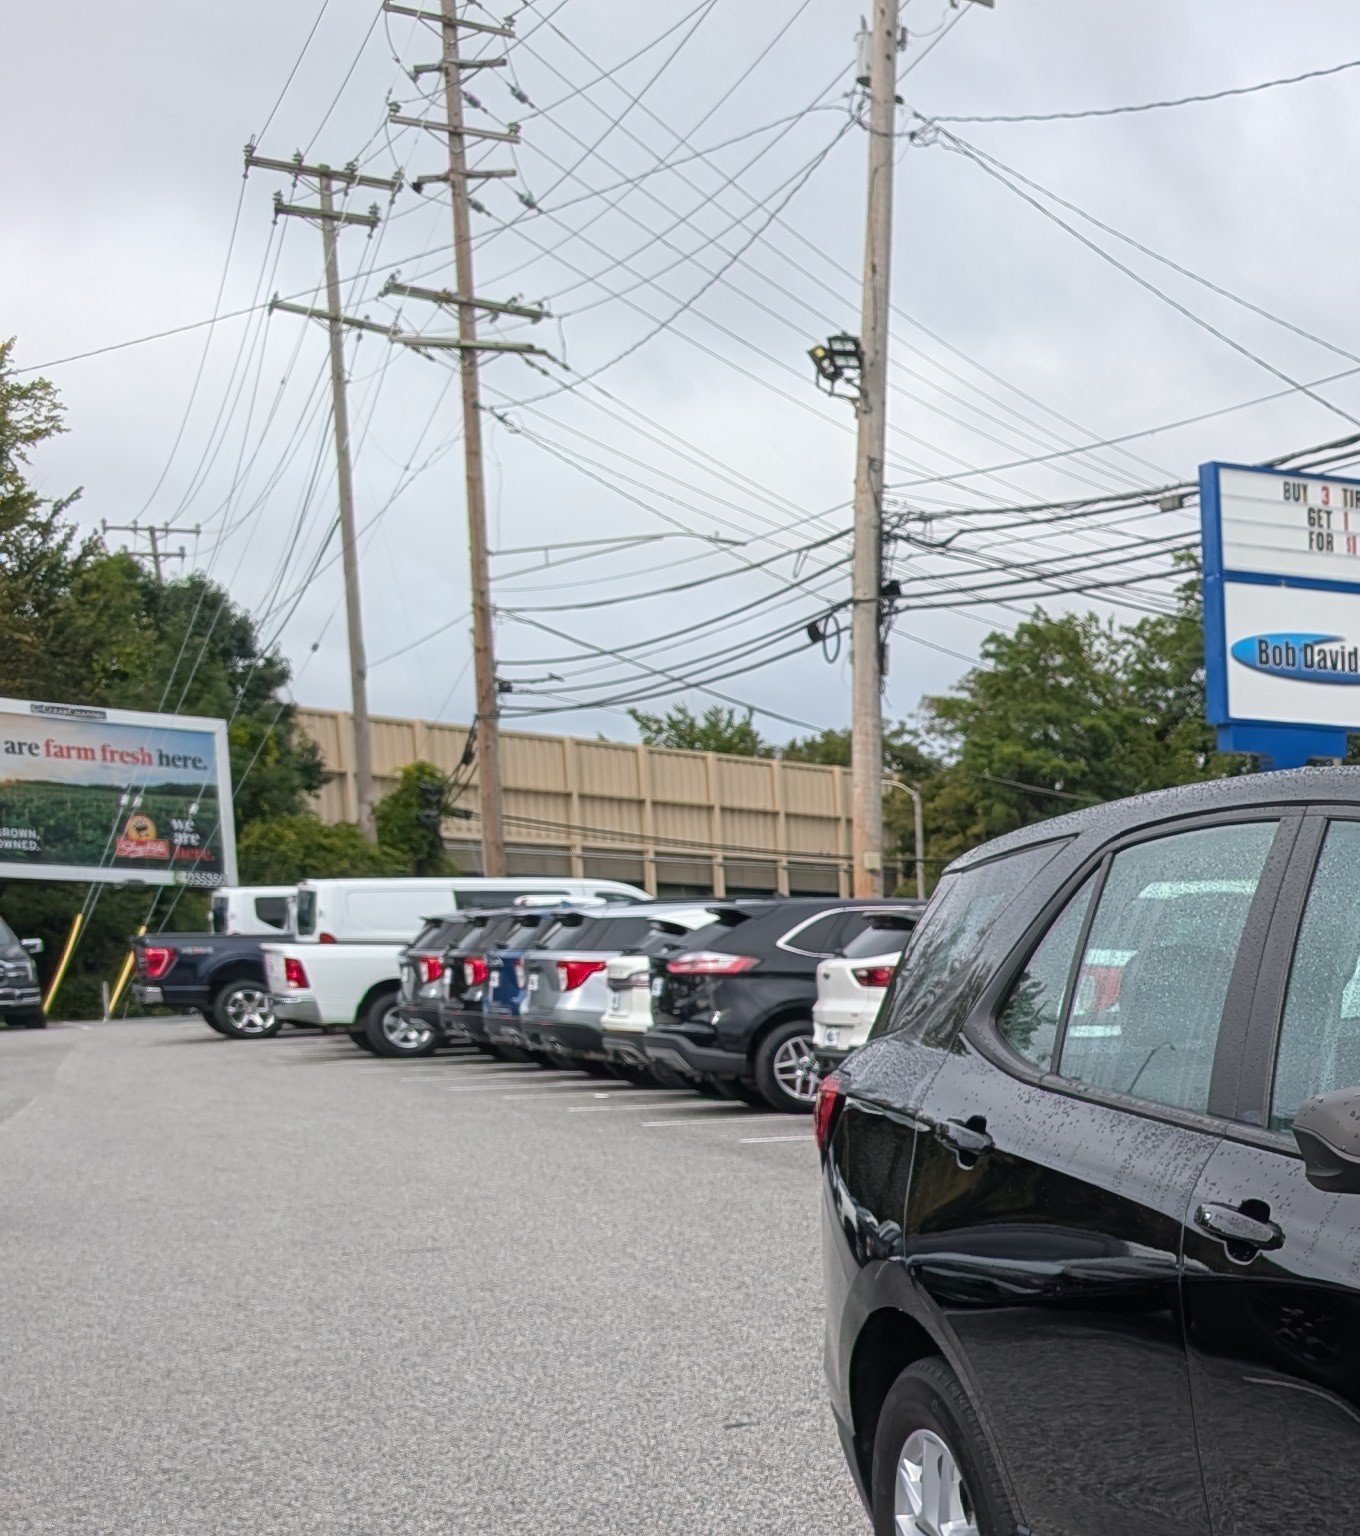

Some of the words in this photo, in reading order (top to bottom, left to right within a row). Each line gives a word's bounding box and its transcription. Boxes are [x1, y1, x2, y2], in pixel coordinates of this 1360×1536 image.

[1282, 481, 1309, 505] BUY
[1320, 485, 1331, 506] 3
[1307, 507, 1332, 529] GET
[1309, 530, 1334, 553] FOR
[1257, 638, 1297, 667] Bob
[4, 739, 40, 758] are
[44, 738, 96, 762] farm
[101, 743, 154, 767] fresh
[157, 750, 208, 772] here.
